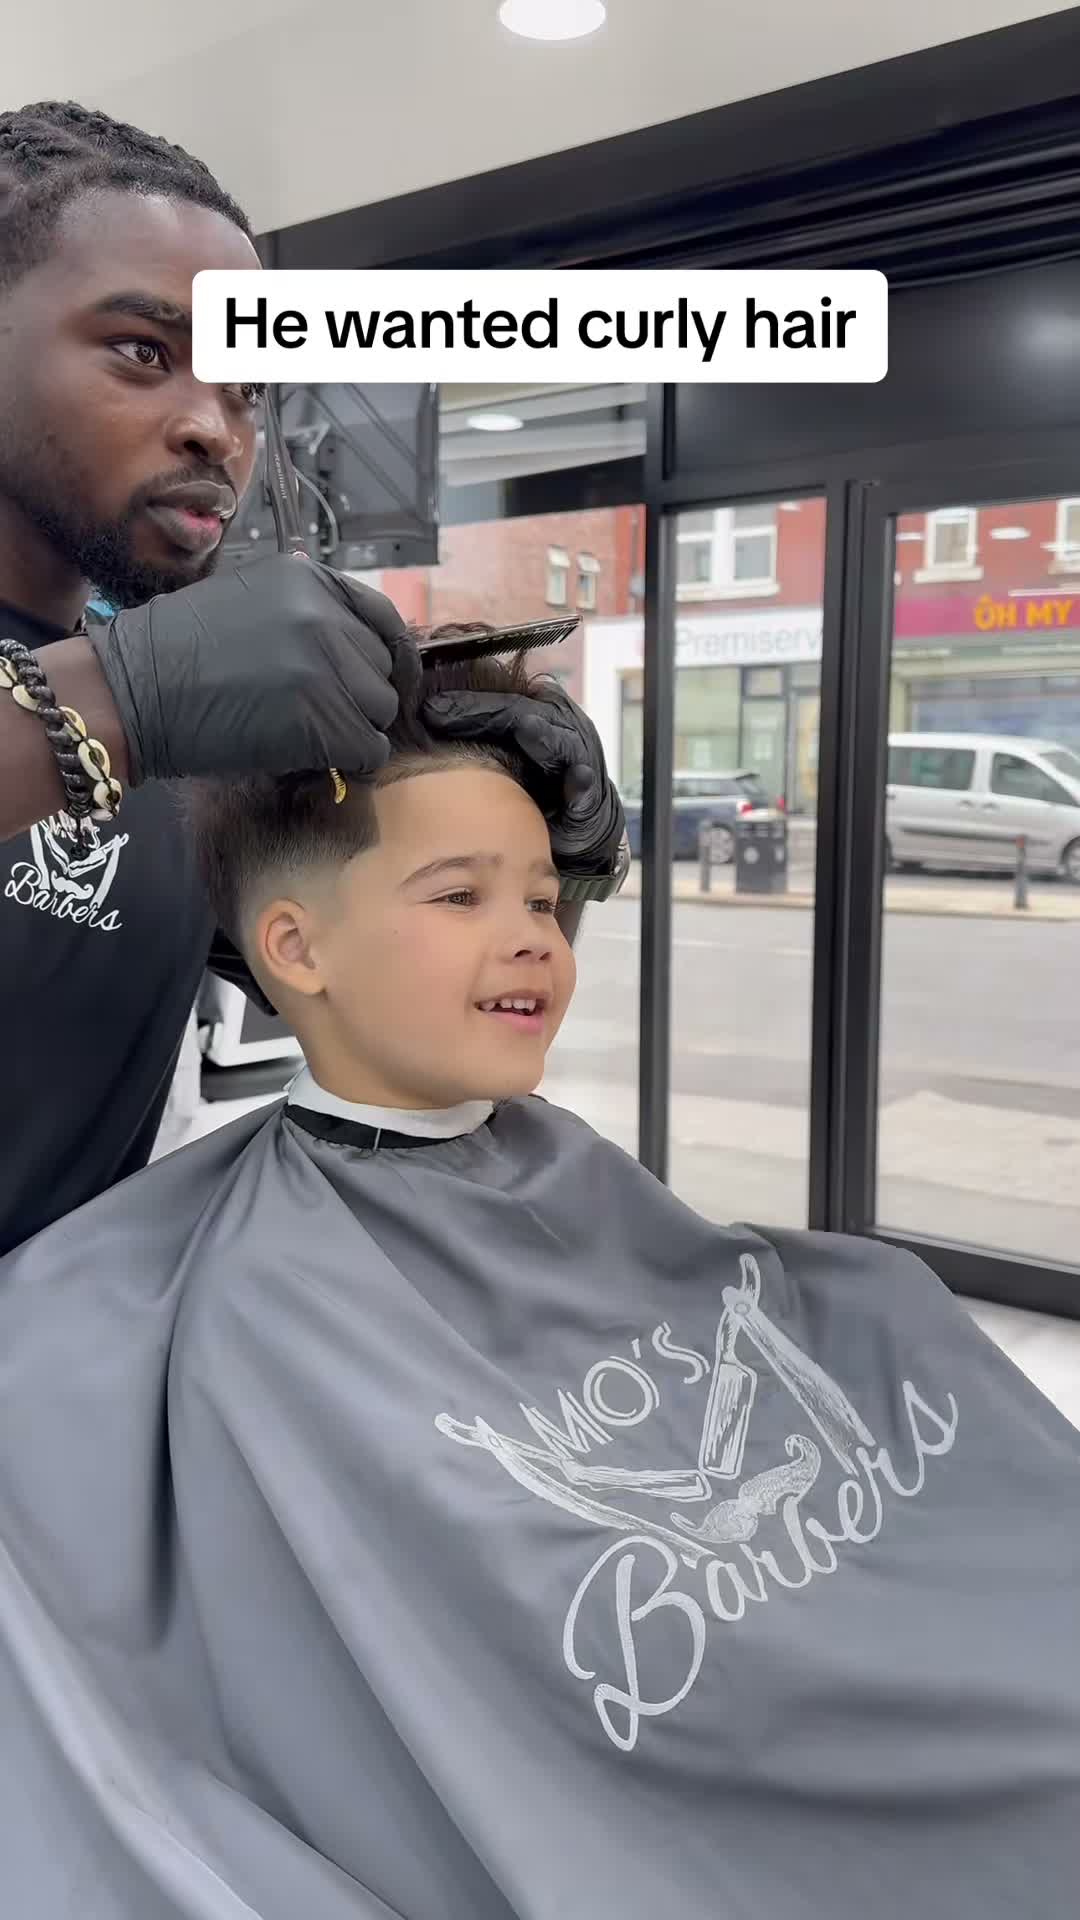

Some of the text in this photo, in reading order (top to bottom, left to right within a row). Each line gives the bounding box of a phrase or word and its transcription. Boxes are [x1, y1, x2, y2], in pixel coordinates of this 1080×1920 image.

[1027, 599, 1072, 629] MY
[4, 861, 122, 931] Barbers
[520, 1321, 711, 1453] MO'S
[563, 1380, 958, 1752] Barbers
